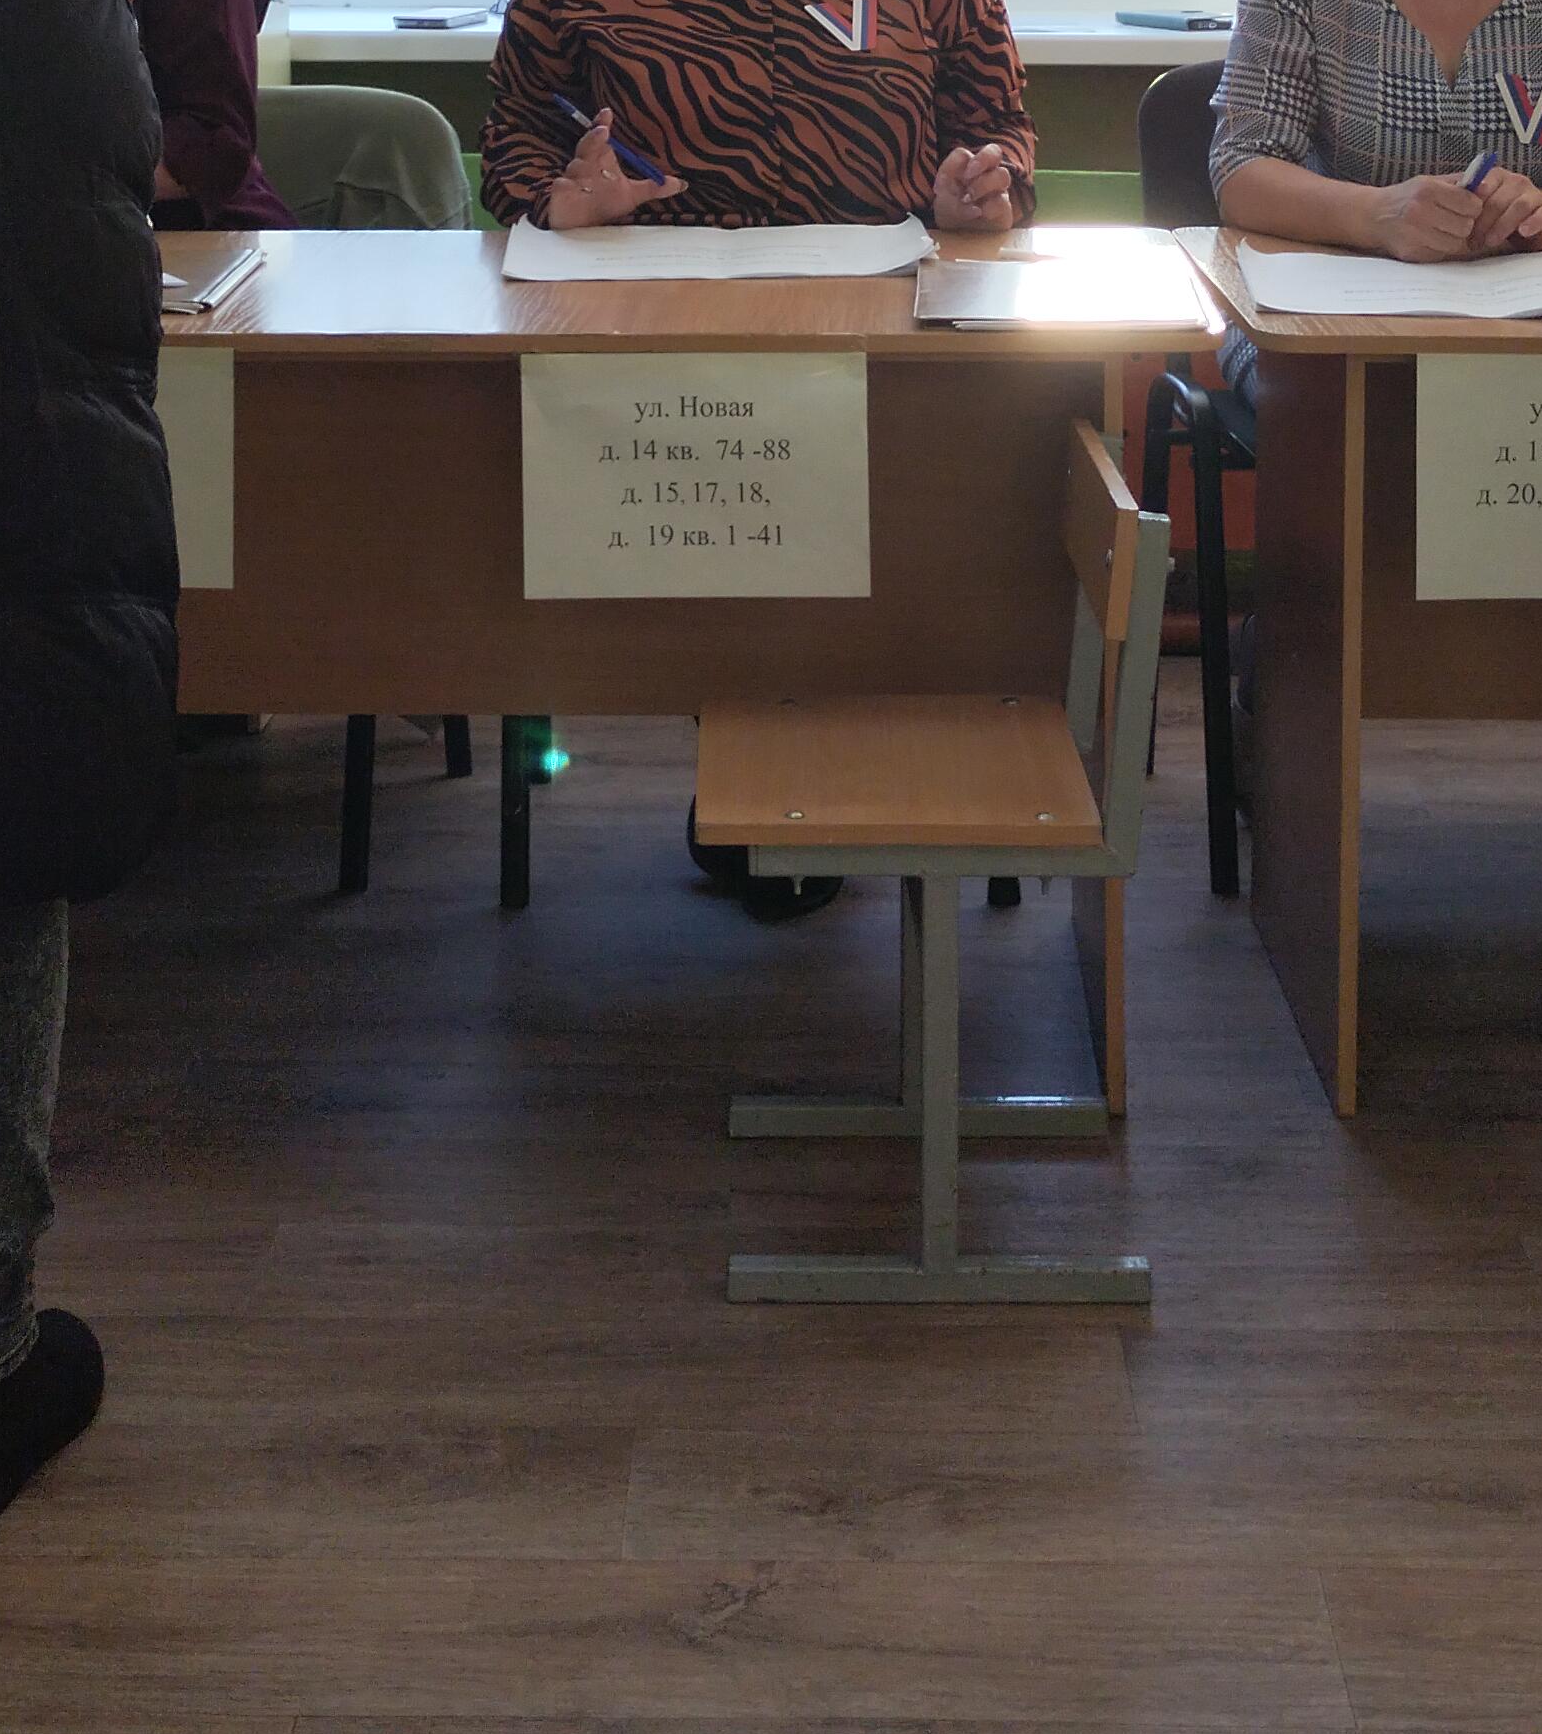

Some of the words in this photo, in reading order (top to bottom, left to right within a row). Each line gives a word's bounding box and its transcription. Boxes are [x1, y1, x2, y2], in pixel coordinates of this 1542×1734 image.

[634, 402, 670, 424] ул.
[679, 395, 754, 418] Новая
[598, 445, 621, 463] д.
[632, 438, 658, 461] 14
[666, 445, 700, 461] кв.
[715, 438, 745, 461] 74
[1494, 446, 1517, 465] д.
[620, 487, 643, 506] д.
[738, 481, 771, 507] 18,
[1475, 489, 1498, 507] д.
[1506, 482, 1542, 508] 20,
[607, 531, 630, 550] д.
[649, 524, 675, 547] 19
[682, 530, 717, 547] кв.
[728, 524, 736, 547] 1
